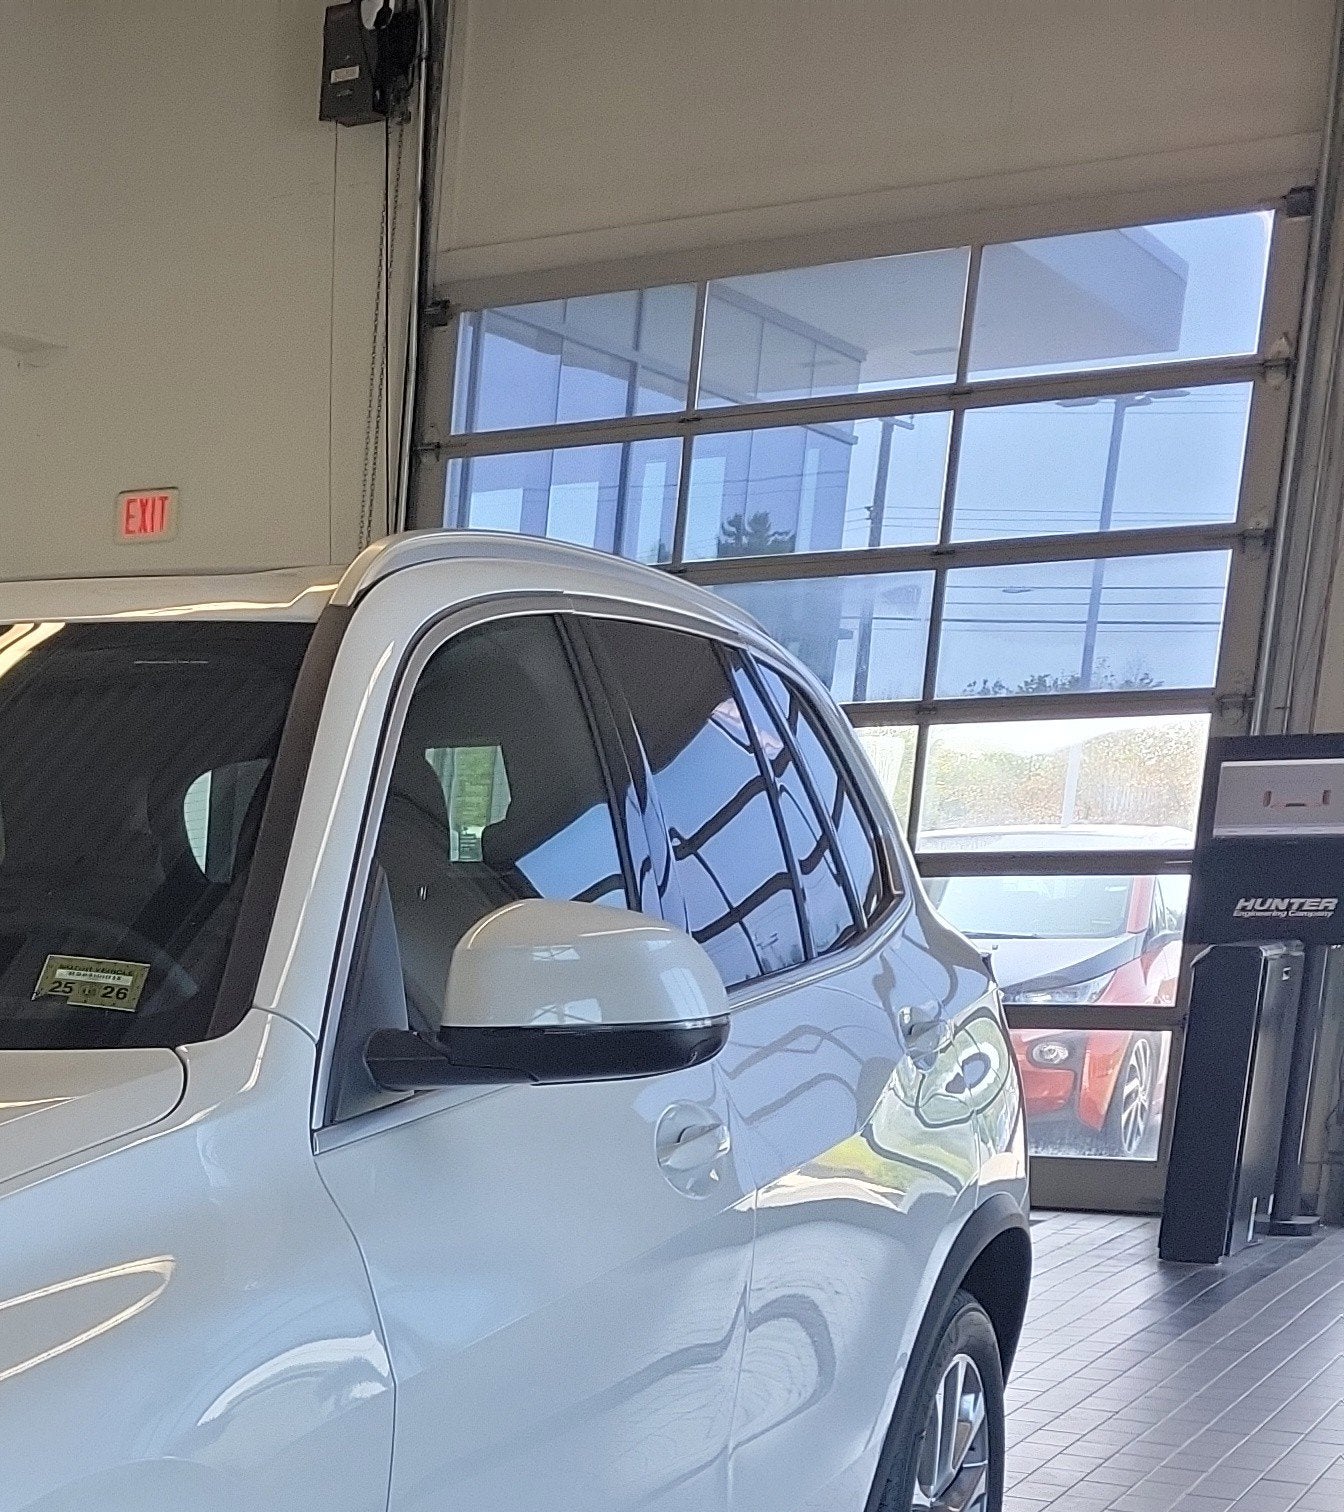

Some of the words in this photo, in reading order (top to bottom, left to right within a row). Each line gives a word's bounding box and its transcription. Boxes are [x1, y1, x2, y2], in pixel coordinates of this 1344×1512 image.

[124, 496, 169, 534] EXIT
[1234, 897, 1339, 911] HUNTER
[1288, 910, 1334, 918] Company
[48, 980, 76, 995] 25
[100, 985, 129, 1001] 26
